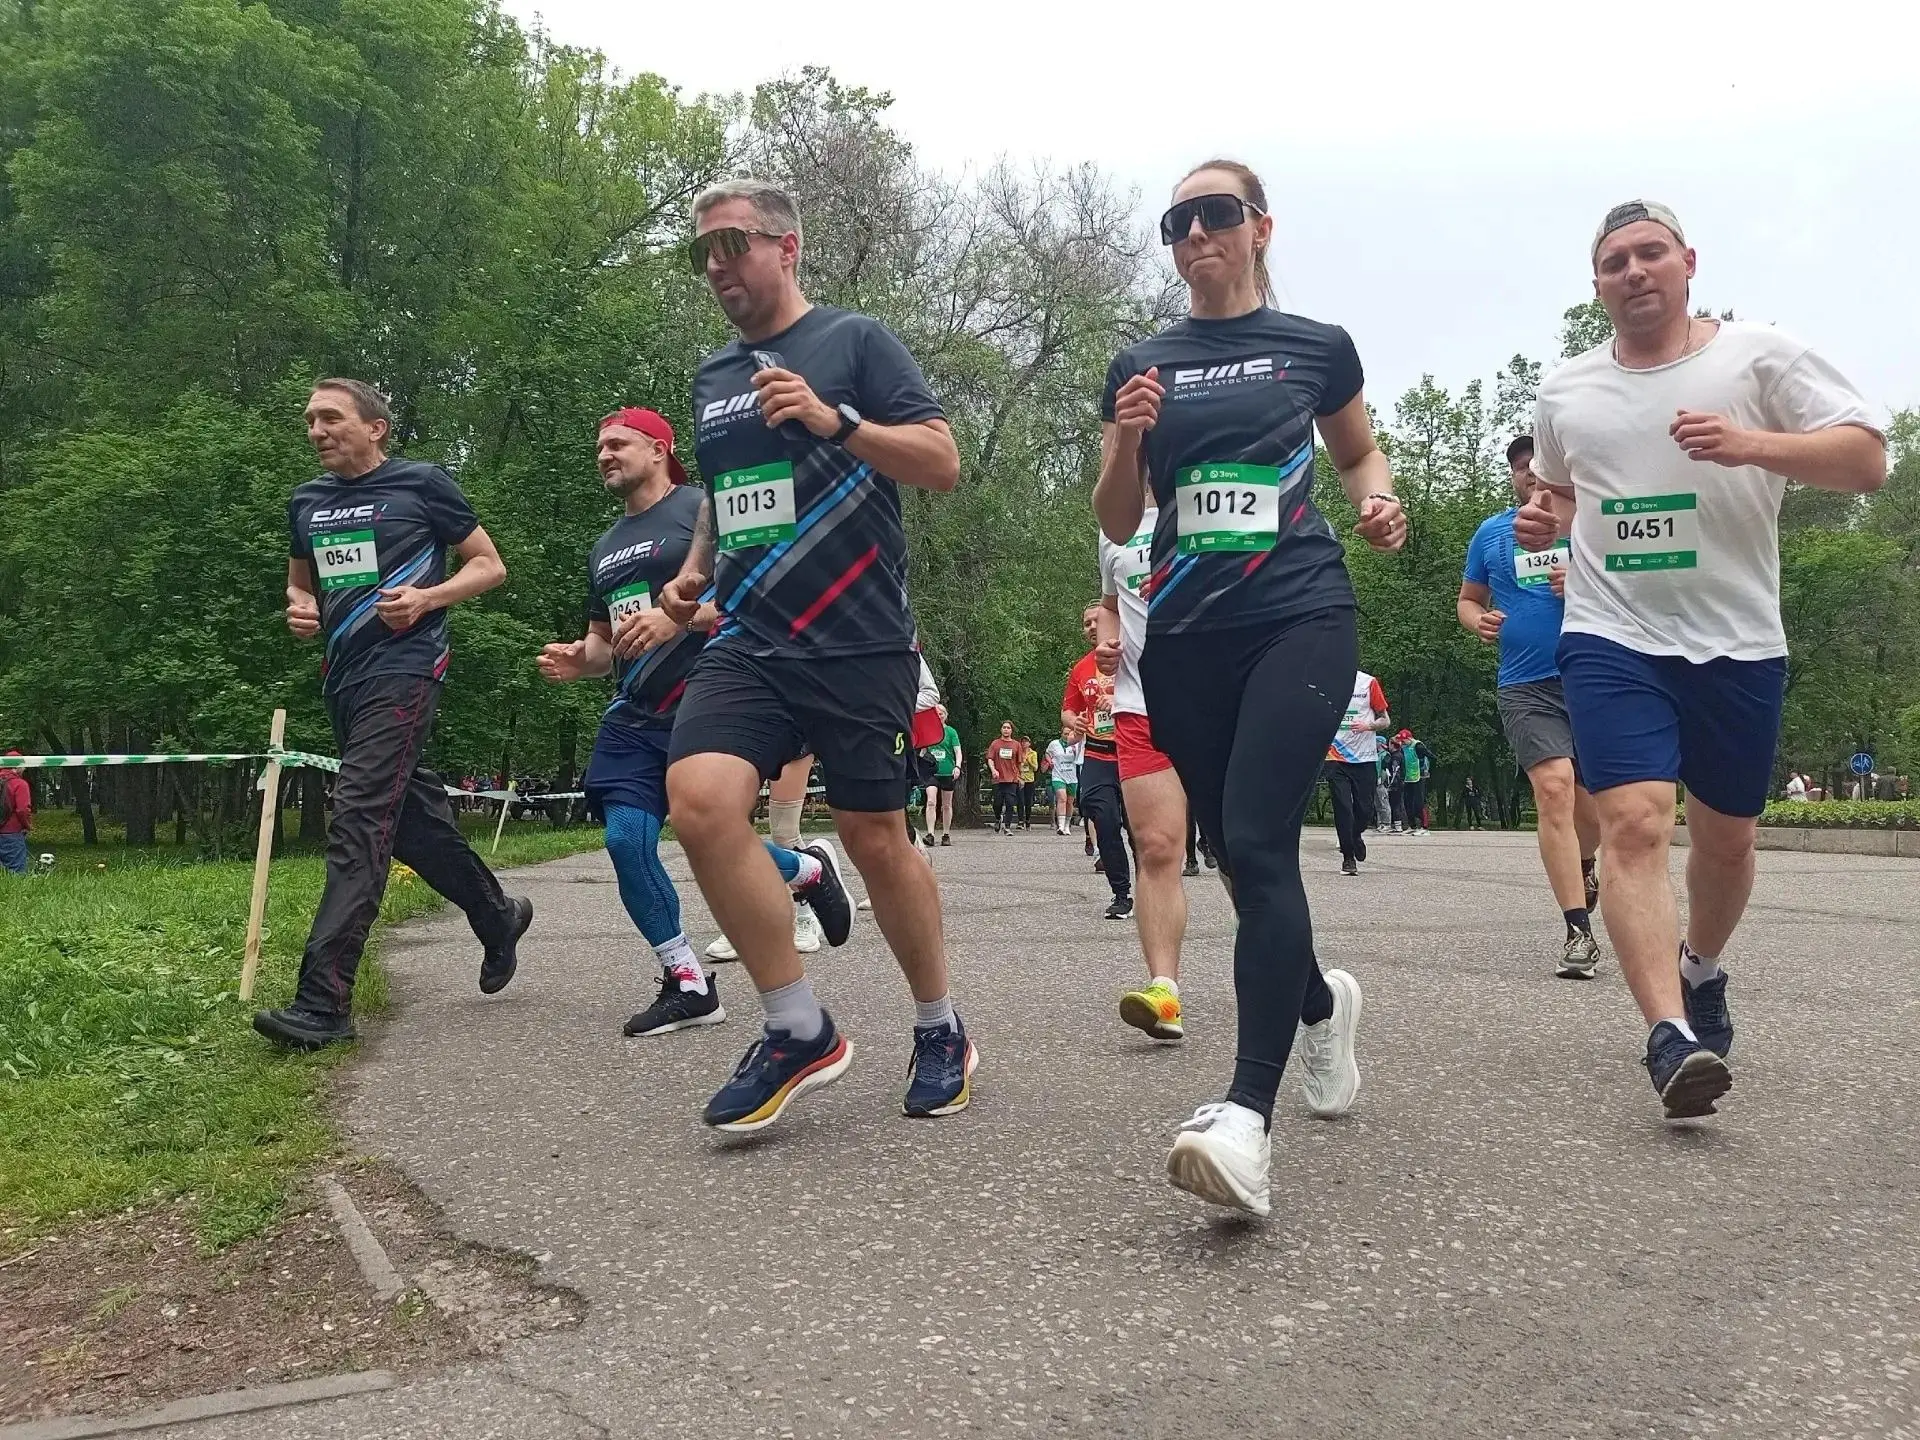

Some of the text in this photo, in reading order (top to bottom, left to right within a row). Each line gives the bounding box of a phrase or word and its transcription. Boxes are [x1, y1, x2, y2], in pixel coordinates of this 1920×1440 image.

[1190, 390, 1210, 398] TEAM
[701, 390, 761, 422] СШ
[1219, 470, 1239, 479] Звук
[726, 488, 776, 517] 1013
[1193, 490, 1257, 516] 1012
[1616, 516, 1674, 541] 0451
[325, 547, 362, 566] 0541
[1525, 552, 1559, 569] 1326
